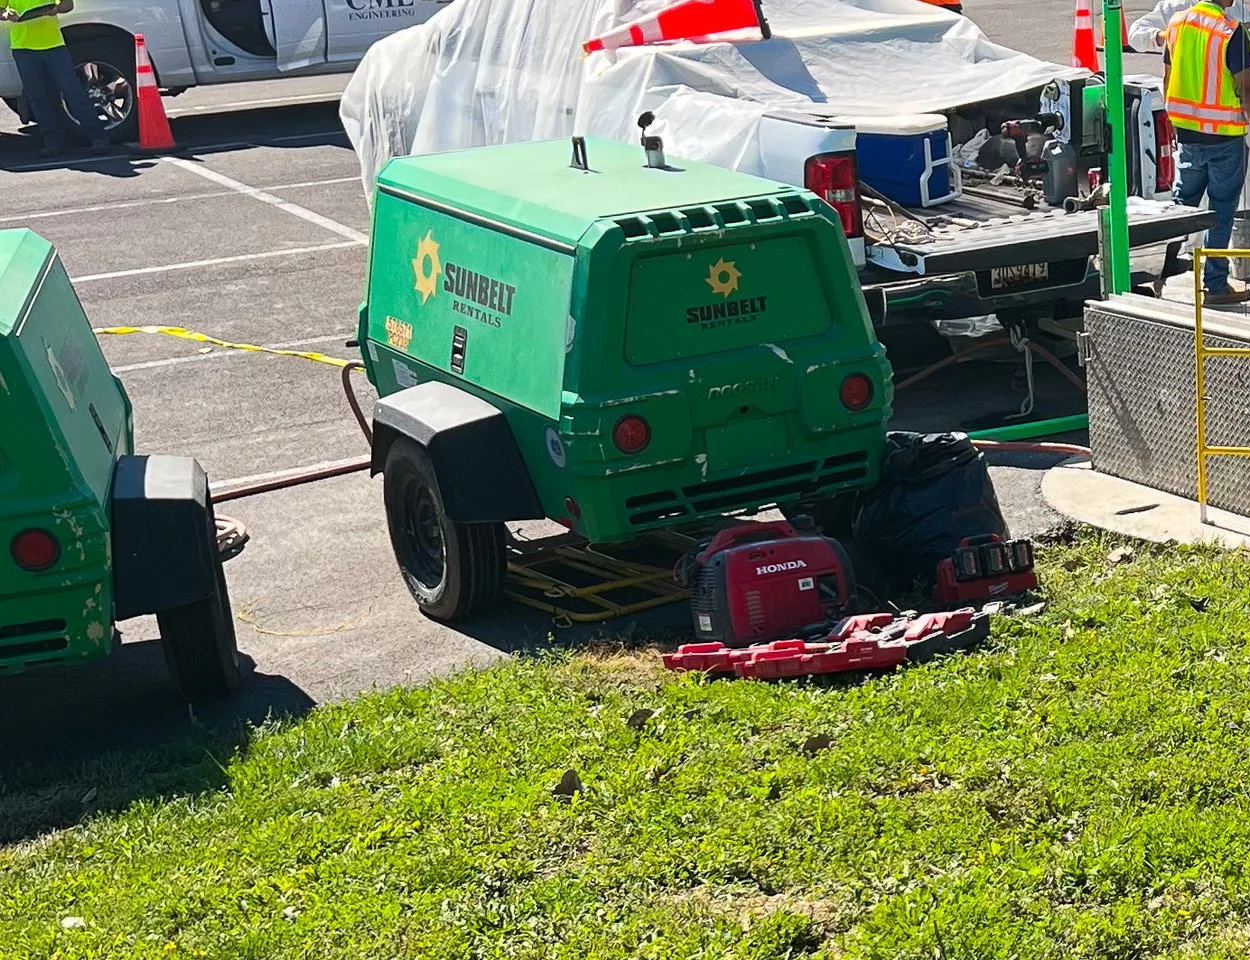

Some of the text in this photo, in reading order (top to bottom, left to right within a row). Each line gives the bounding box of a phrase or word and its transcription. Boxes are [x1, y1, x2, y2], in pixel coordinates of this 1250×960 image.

[349, 9, 415, 21] ENGINEERING
[443, 262, 516, 316] SUNBELT
[452, 300, 501, 328] RENTALS
[686, 296, 768, 324] SUNBELT
[701, 315, 758, 330] RENTALS
[756, 560, 807, 575] HONDA
